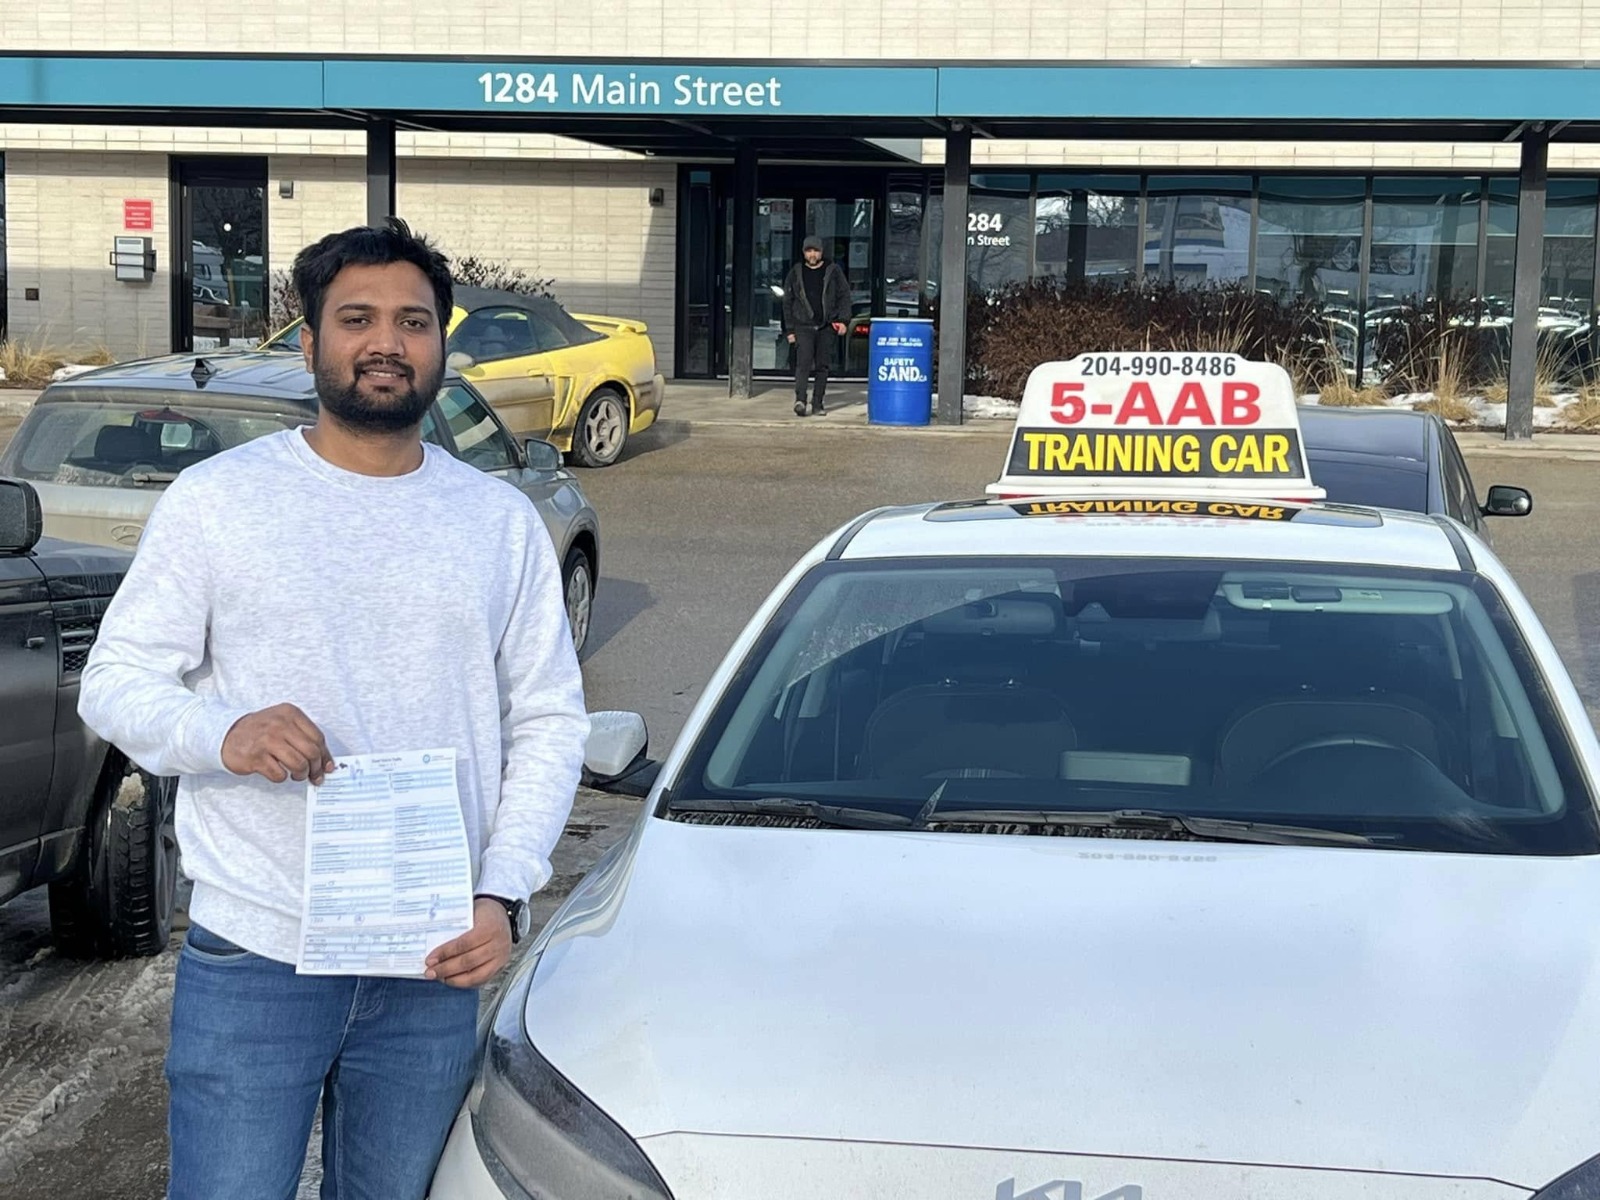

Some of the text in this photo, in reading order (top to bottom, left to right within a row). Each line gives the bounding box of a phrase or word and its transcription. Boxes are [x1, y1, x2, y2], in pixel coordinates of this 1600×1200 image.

[478, 72, 782, 106] 1284 Main Street
[967, 213, 1003, 232] 284
[977, 234, 1010, 246] Street
[883, 357, 915, 366] SAFETY
[1081, 356, 1236, 376] 204-990-8486
[1050, 381, 1261, 425] 5-AAB
[1023, 433, 1290, 473] TRAINING CAR
